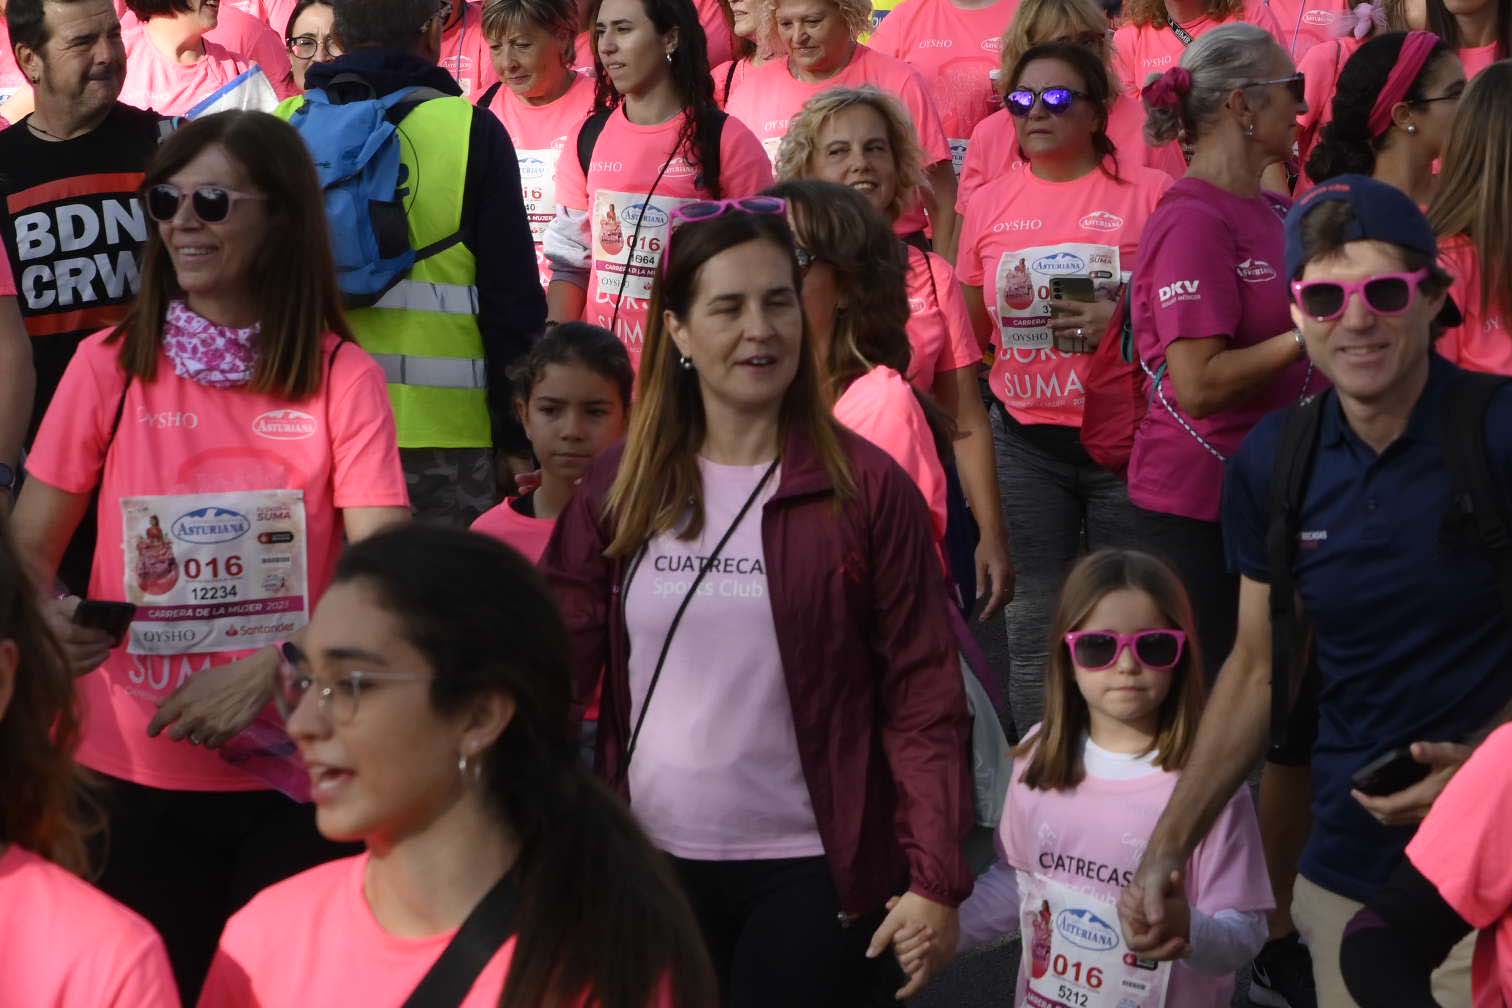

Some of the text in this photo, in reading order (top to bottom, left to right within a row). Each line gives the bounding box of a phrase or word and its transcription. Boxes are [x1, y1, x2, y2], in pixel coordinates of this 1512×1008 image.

[15, 198, 149, 261] BDN
[993, 218, 1043, 233] OYSHO
[1036, 258, 1080, 271] ASTURIANA
[1158, 279, 1200, 302] DKV
[1004, 368, 1086, 400] SUMA
[256, 512, 291, 522] SUMA
[177, 521, 245, 538] ASTURIANA
[184, 555, 244, 580] 016
[191, 585, 238, 601] 12234
[148, 608, 194, 618] CARRERA
[195, 607, 210, 616] DE
[212, 606, 225, 615] LA
[143, 629, 197, 643] OYSHO
[239, 621, 295, 637] Santander
[1053, 953, 1104, 989] 016
[1058, 984, 1089, 1007] 5212
